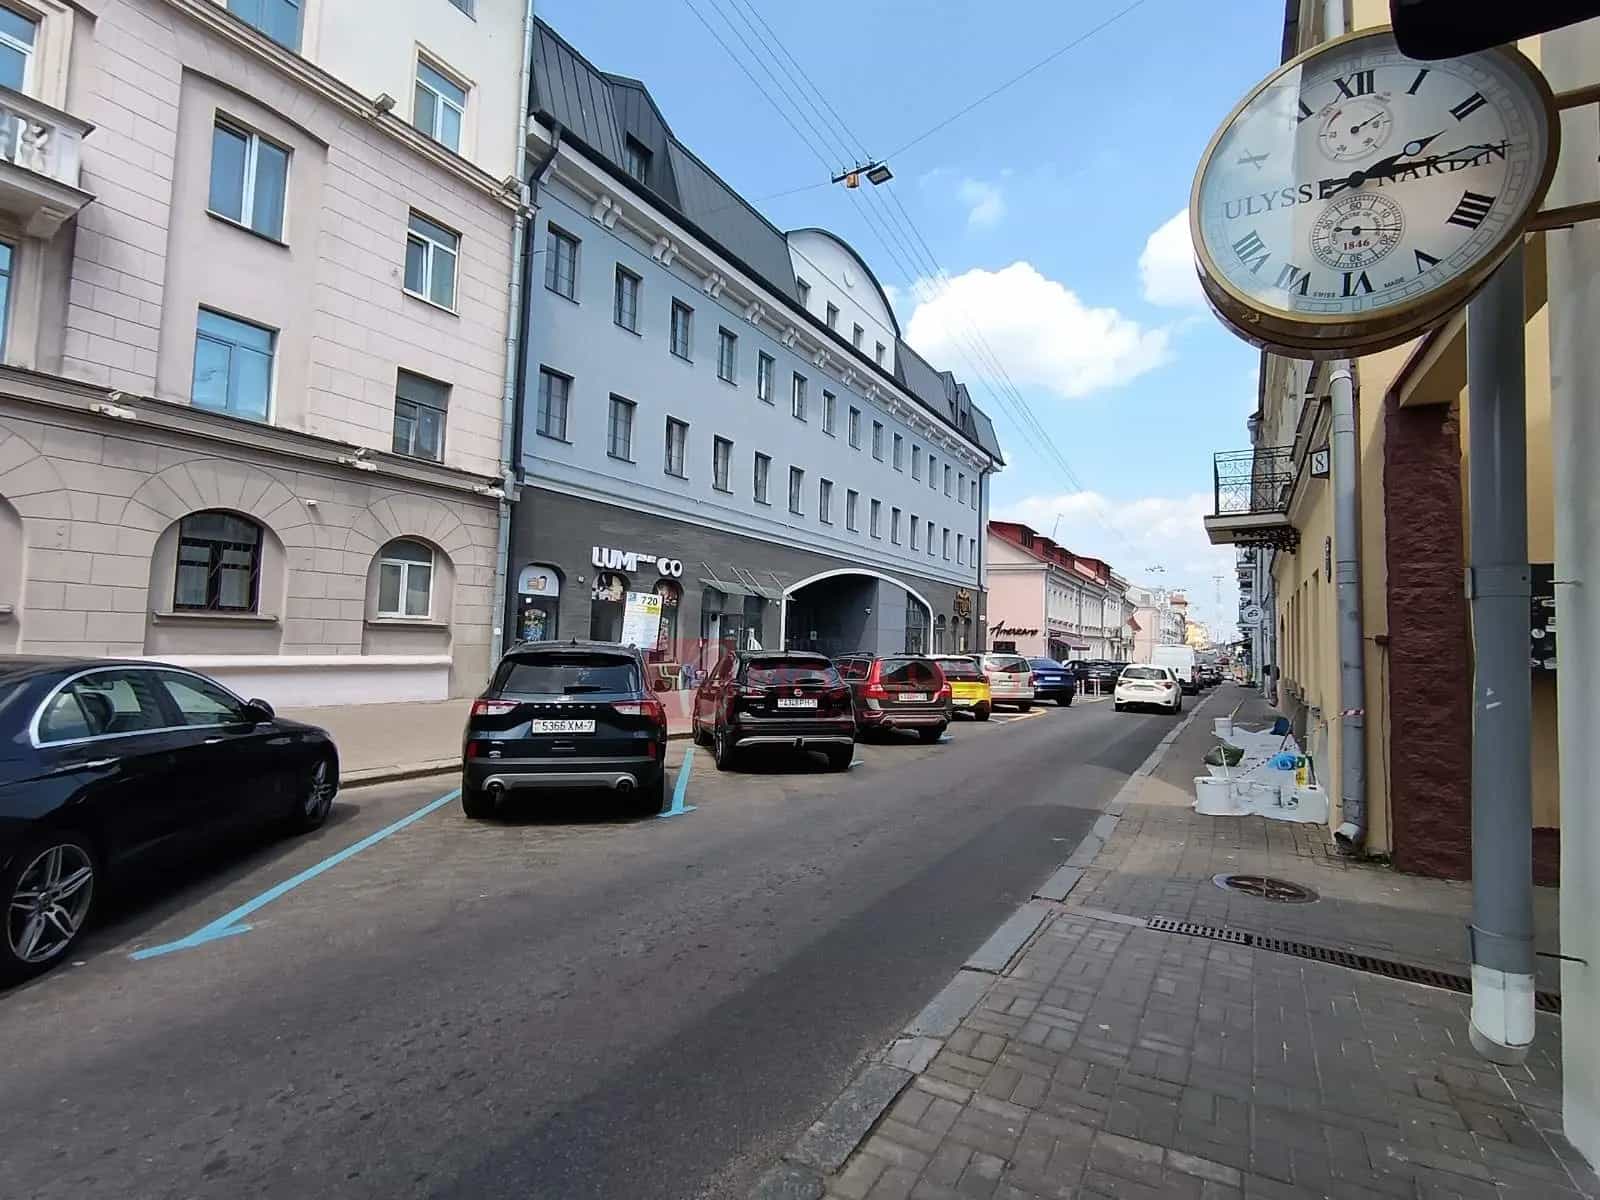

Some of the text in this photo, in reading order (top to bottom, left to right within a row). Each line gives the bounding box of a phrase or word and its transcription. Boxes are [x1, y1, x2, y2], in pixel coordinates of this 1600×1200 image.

[1332, 69, 1377, 101] XII
[1405, 69, 1430, 95] I
[1449, 91, 1488, 122] II
[1223, 180, 1334, 220] ULYSSE
[1343, 239, 1371, 251] 1846
[1339, 269, 1377, 298] VI
[1314, 453, 1325, 473] 8
[641, 596, 658, 606] 720
